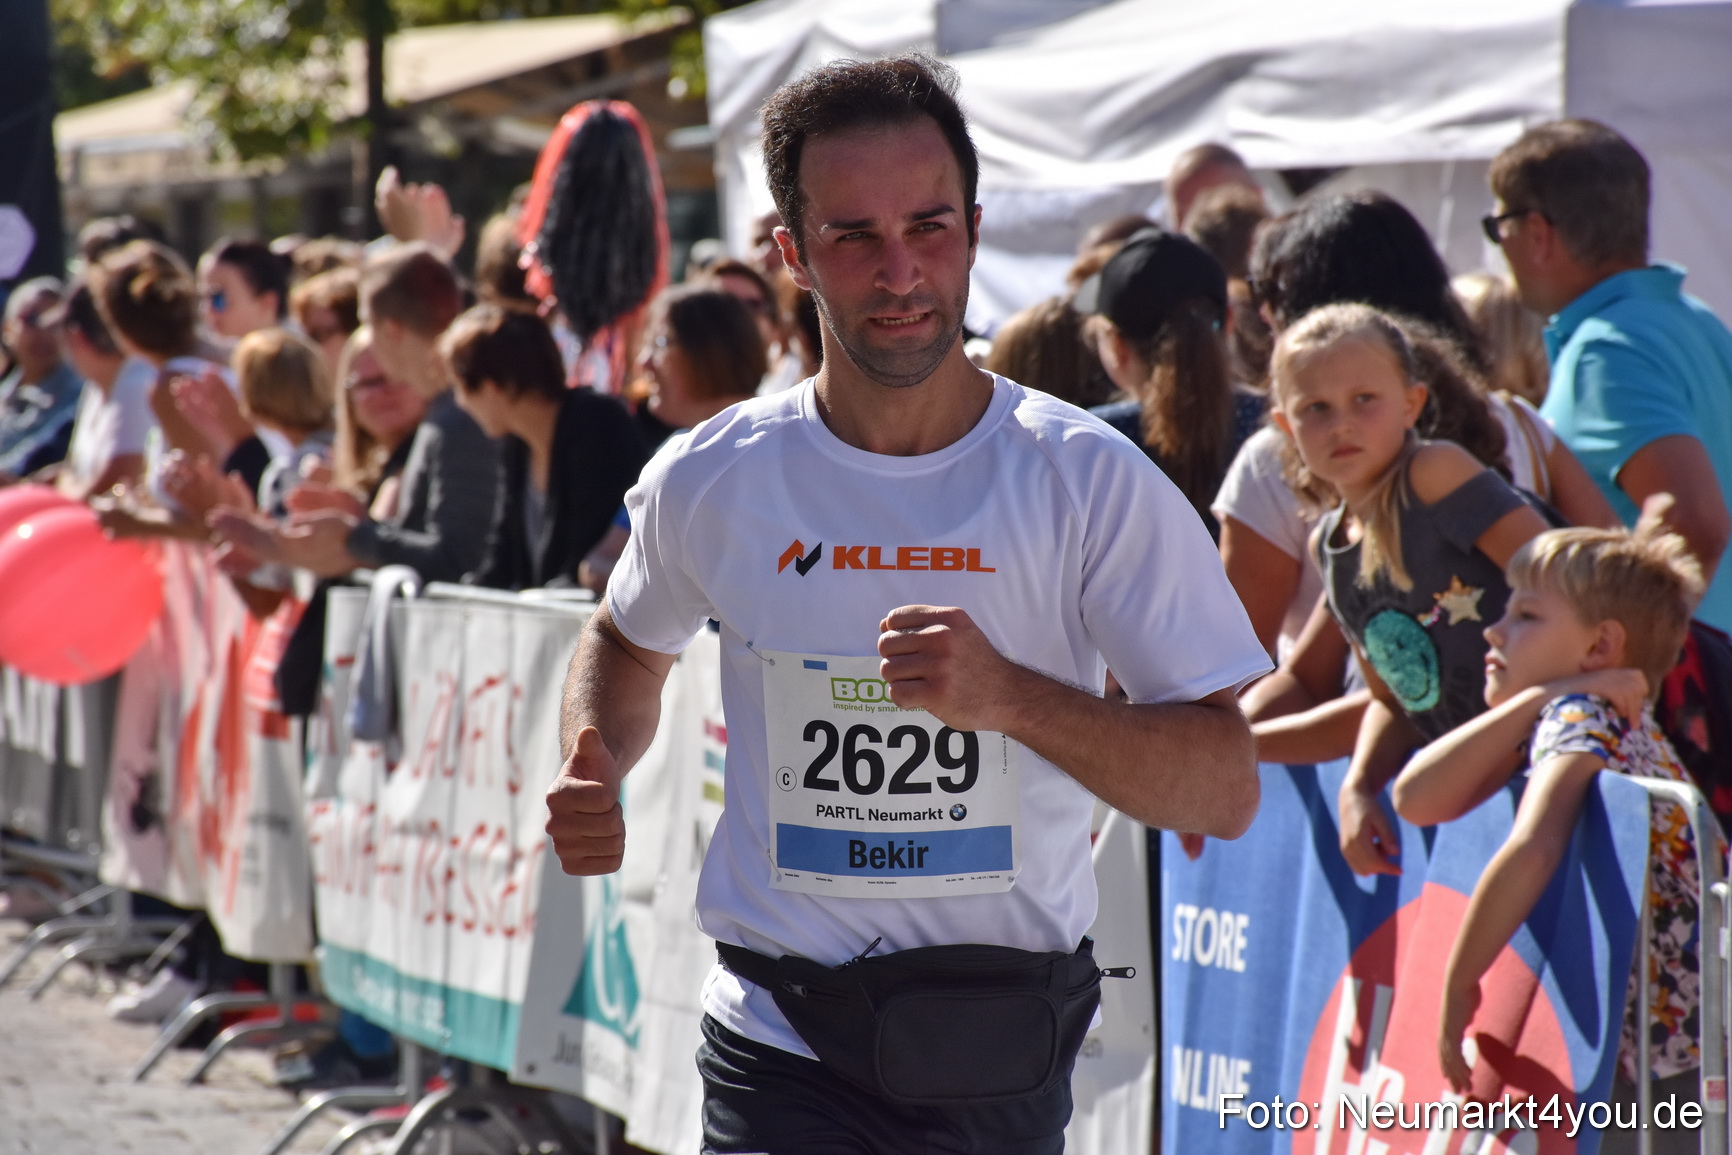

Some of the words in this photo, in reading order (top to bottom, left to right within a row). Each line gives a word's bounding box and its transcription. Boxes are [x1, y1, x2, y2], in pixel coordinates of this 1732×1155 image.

[833, 545, 996, 573] KLEBL
[833, 701, 863, 712] inspired
[865, 704, 875, 713] by
[803, 719, 979, 795] 2629
[782, 773, 790, 786] C
[816, 804, 864, 821] PARTL
[868, 807, 943, 821] Neumarkt
[848, 839, 929, 869] Bekir
[1172, 902, 1249, 973] STORE
